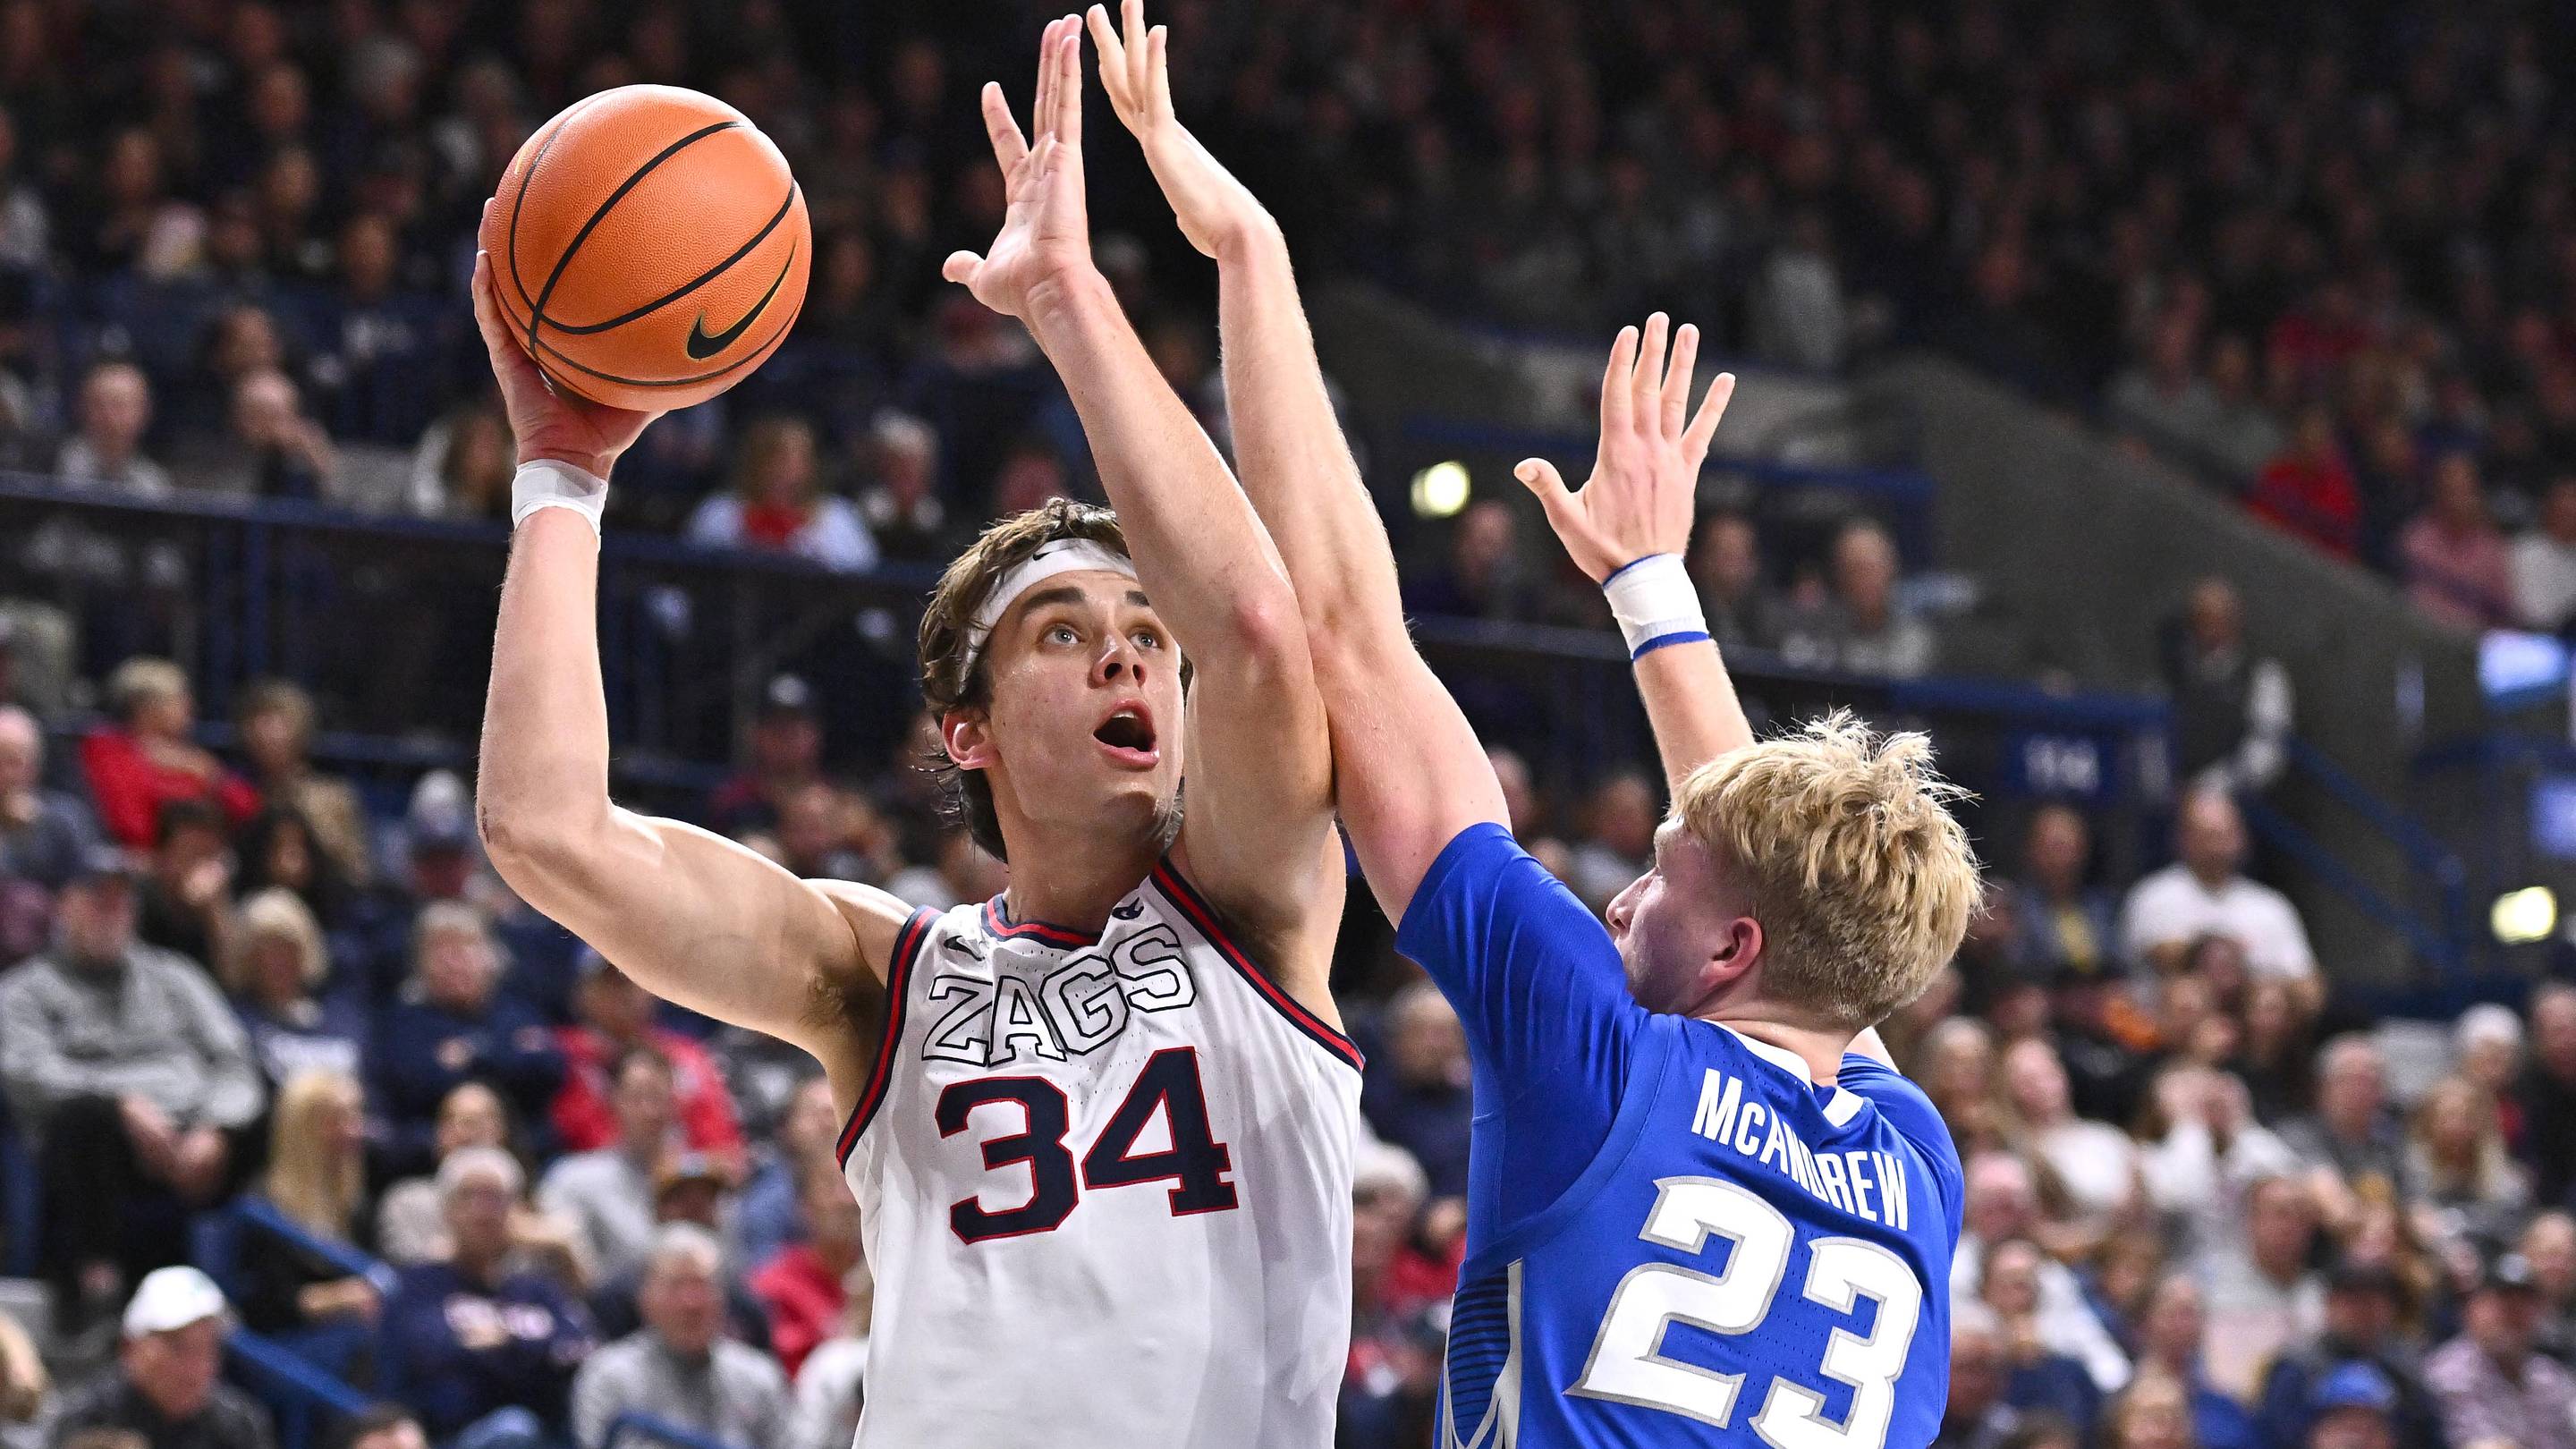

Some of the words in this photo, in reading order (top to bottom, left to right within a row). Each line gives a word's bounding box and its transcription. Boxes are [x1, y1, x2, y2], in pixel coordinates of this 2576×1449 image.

[922, 923, 1197, 1067] ZAGS
[935, 1046, 1239, 1245] 34
[1563, 1175, 1922, 1449] 23
